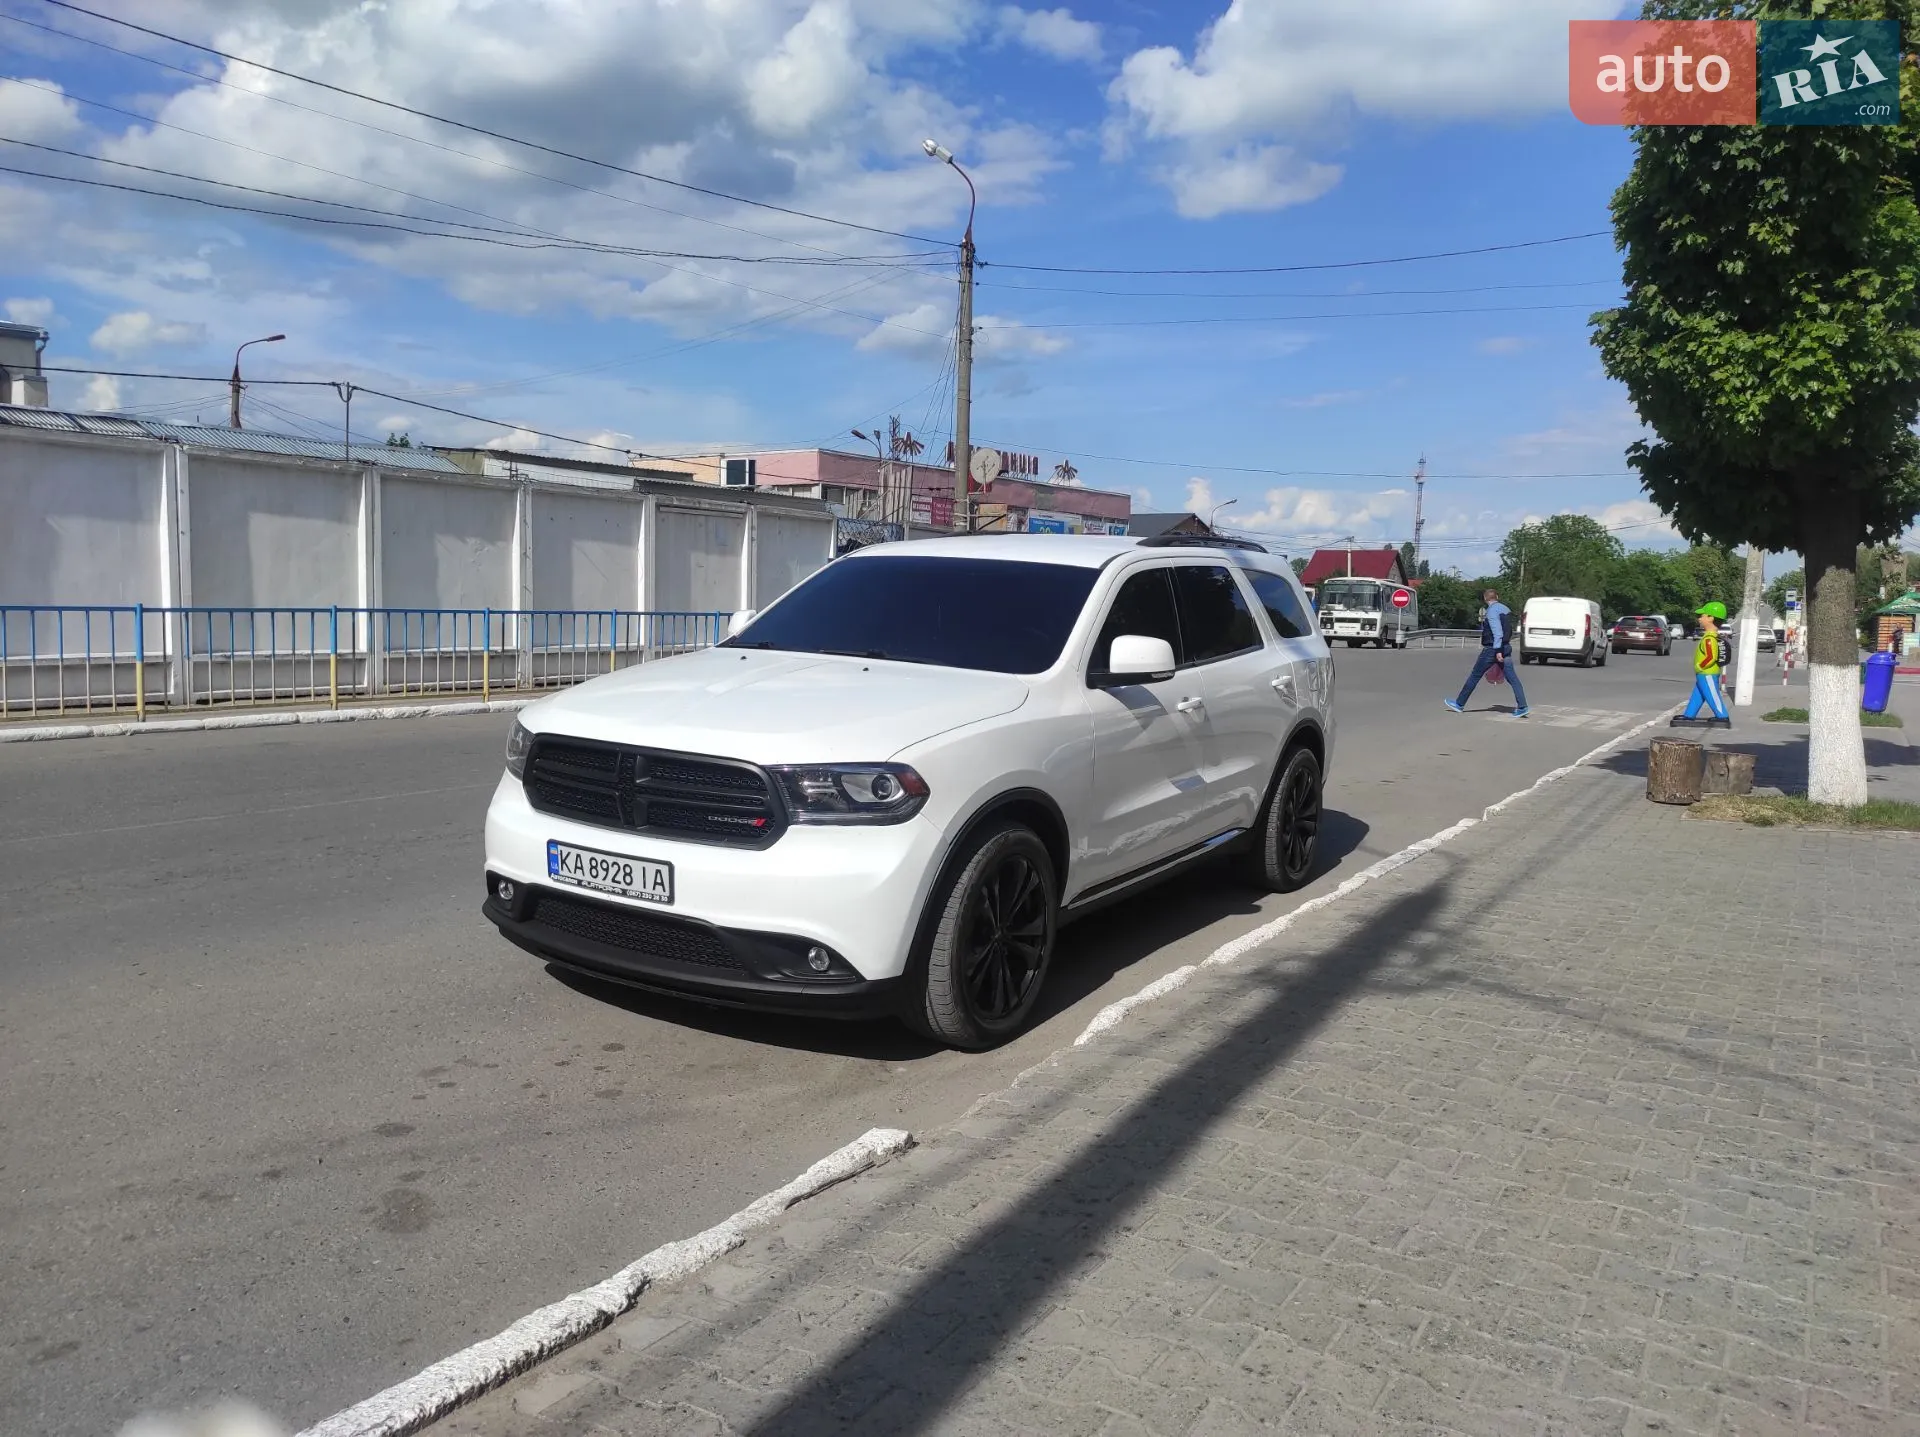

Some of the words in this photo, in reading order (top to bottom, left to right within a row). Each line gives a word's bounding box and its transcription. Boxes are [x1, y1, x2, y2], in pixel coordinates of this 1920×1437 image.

[708, 815, 758, 825] DODGE
[560, 850, 585, 876] KA
[589, 857, 633, 886] 8928
